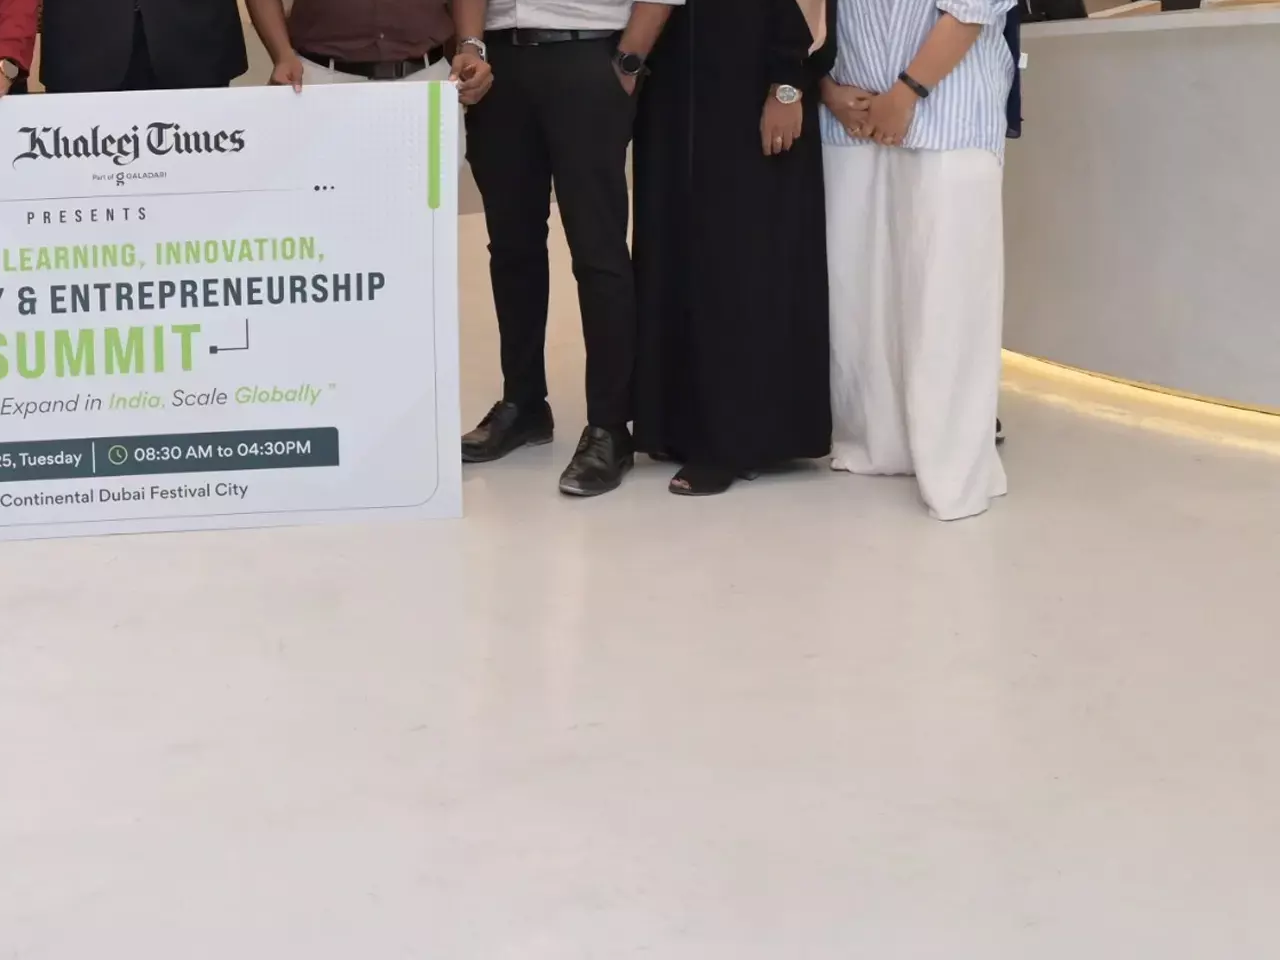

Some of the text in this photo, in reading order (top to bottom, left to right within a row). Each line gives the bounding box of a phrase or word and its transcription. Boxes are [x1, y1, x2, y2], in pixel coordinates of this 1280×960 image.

[12, 121, 246, 171] Khaleej Times
[92, 173, 106, 181] Part
[27, 206, 147, 225] PRESENTS
[2, 243, 145, 273] LEARNING,
[156, 236, 325, 265] INNOVATION,
[17, 286, 37, 316] &
[50, 271, 386, 314] ENTREPRENEURSHIP
[0, 394, 80, 419] Expand
[84, 394, 102, 412] in
[108, 392, 166, 410] India.
[171, 387, 228, 408] Scale
[234, 383, 322, 406] Globally
[19, 450, 83, 468] Tuesday
[134, 440, 312, 462] 08:30 AM to 04:30PM
[99, 486, 146, 503] Dubai
[150, 483, 211, 500] Festival
[214, 482, 249, 500] City
